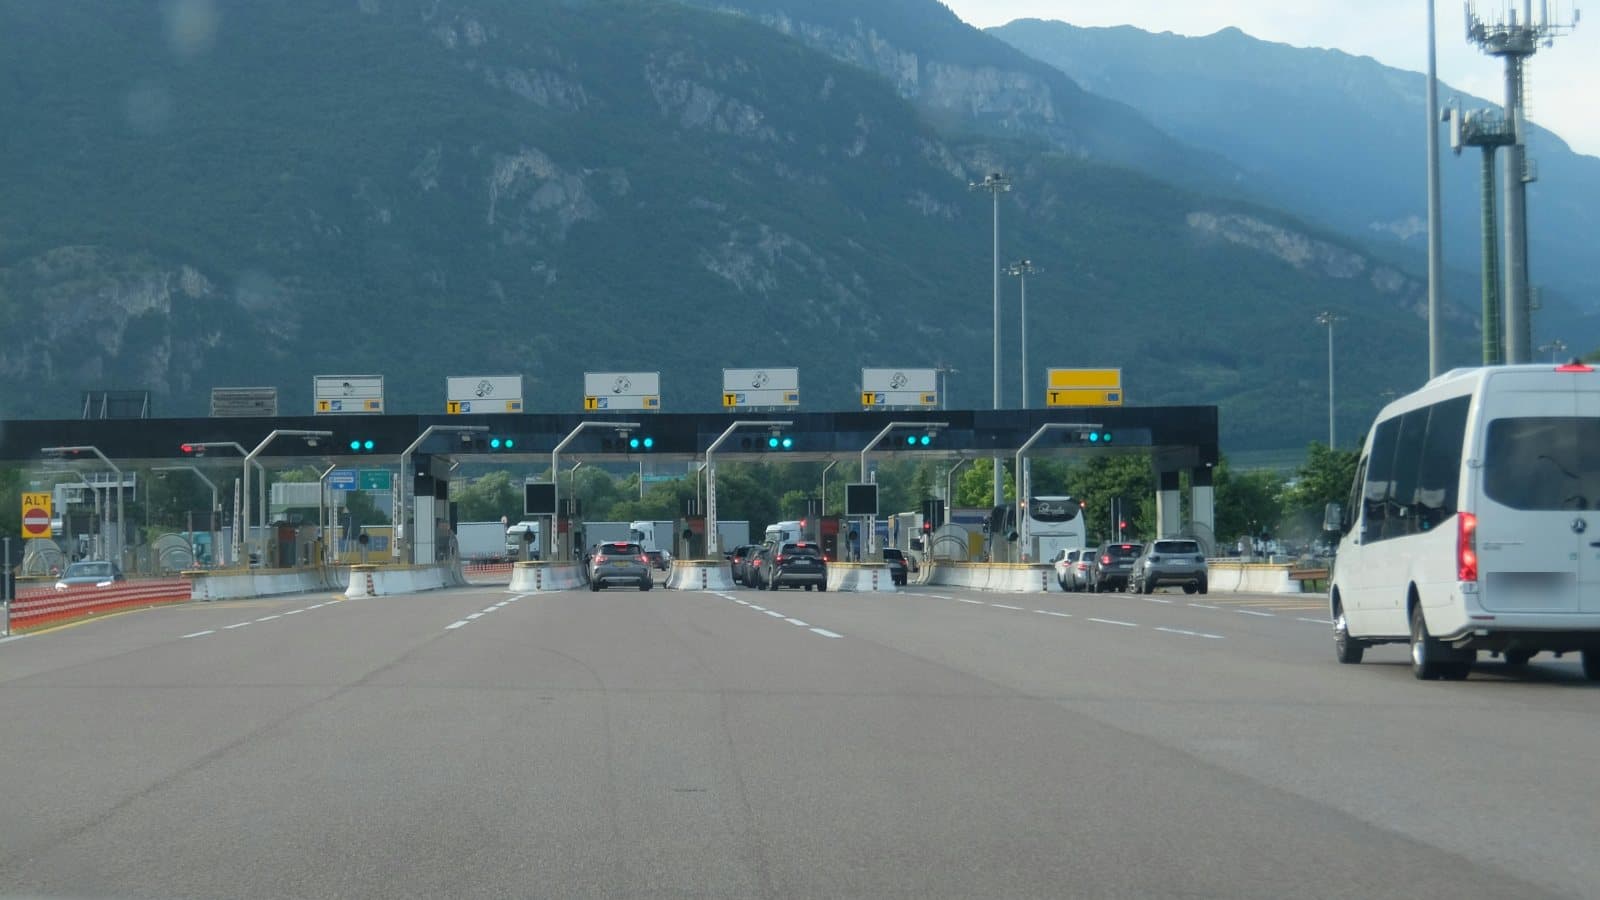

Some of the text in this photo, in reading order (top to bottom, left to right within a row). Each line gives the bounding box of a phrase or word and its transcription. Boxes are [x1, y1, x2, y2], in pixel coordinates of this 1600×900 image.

[725, 394, 734, 405] T
[864, 393, 873, 403] T
[1050, 392, 1059, 403] T
[319, 401, 328, 410] T
[448, 402, 459, 412] T
[586, 398, 596, 408] T
[24, 495, 49, 506] ALT
